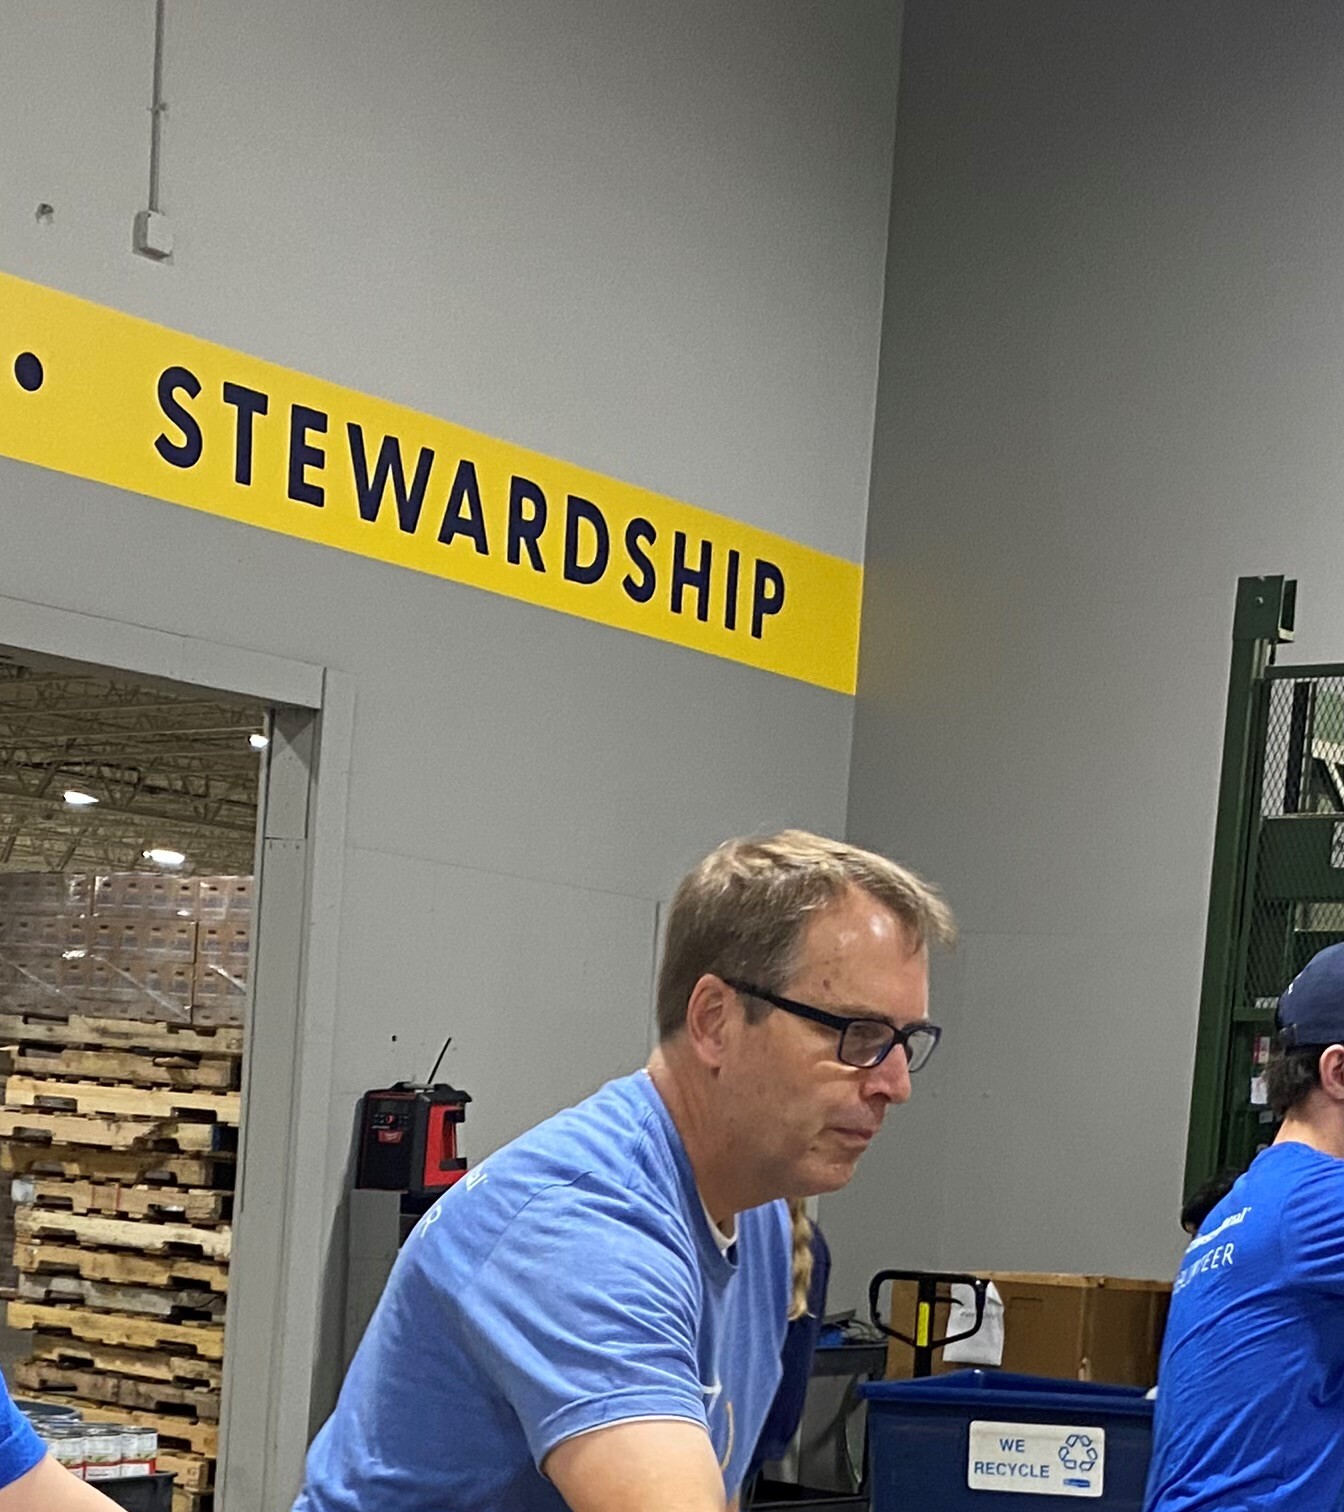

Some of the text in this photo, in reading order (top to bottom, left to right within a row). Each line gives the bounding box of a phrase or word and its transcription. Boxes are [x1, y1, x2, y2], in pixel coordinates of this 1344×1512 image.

[153, 365, 786, 639] STEWARDSHIP
[999, 1438, 1025, 1453] WE
[974, 1461, 1050, 1478] RECYCLE
